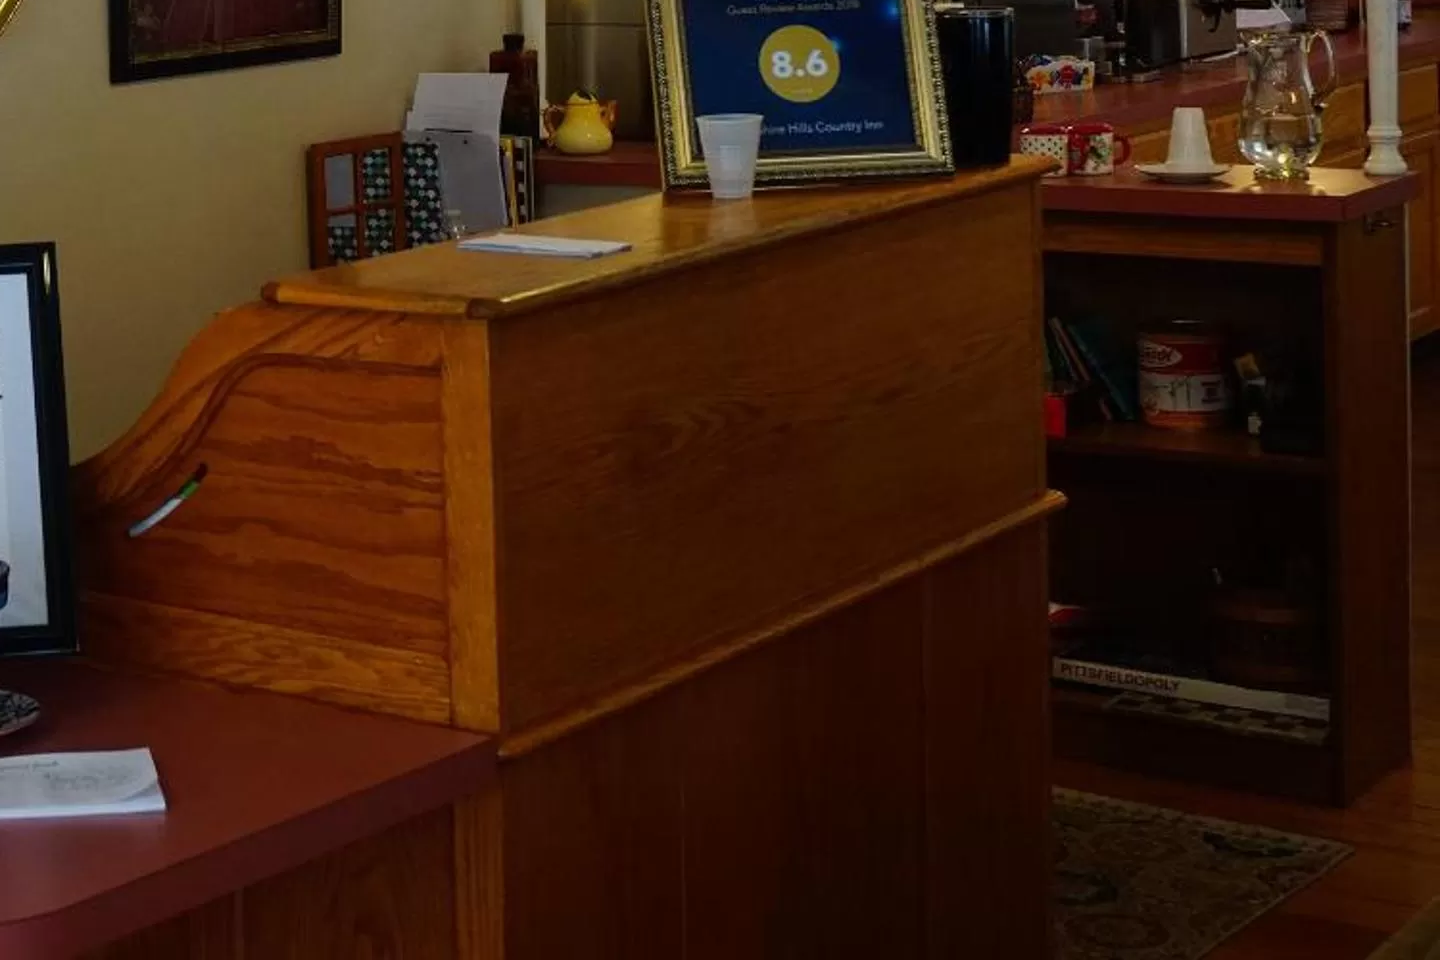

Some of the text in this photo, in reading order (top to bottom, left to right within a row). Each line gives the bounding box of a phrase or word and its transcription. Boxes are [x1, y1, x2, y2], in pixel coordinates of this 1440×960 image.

[771, 49, 828, 79] 8.6
[788, 120, 812, 135] Hills
[815, 120, 861, 135] Country
[863, 119, 884, 131] Inn
[1060, 662, 1181, 691] PITTSFIELDOPOLY
